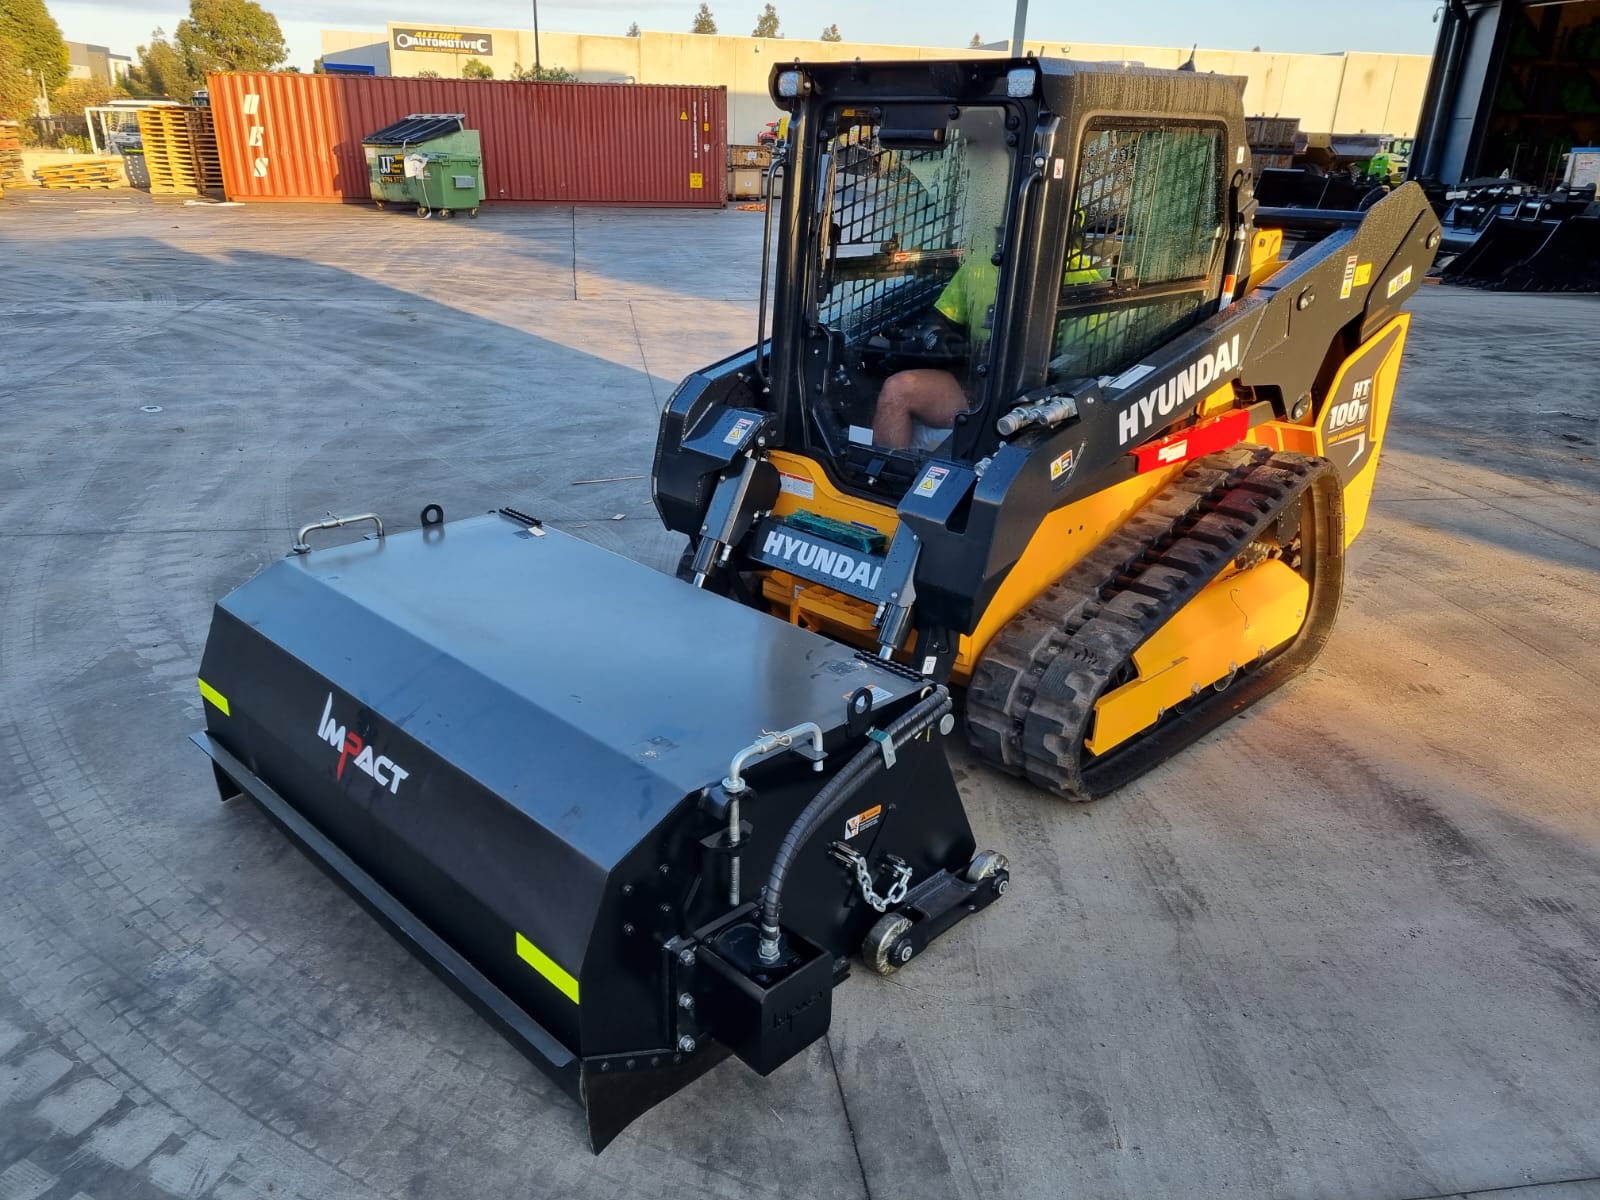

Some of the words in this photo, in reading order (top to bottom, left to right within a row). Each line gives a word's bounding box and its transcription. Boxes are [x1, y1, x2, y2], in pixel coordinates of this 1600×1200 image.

[410, 37, 477, 50] AUTOMOTIVE
[1118, 334, 1240, 446] HYUNDAI
[1352, 379, 1373, 399] HT
[762, 530, 882, 590] HYUNDAI
